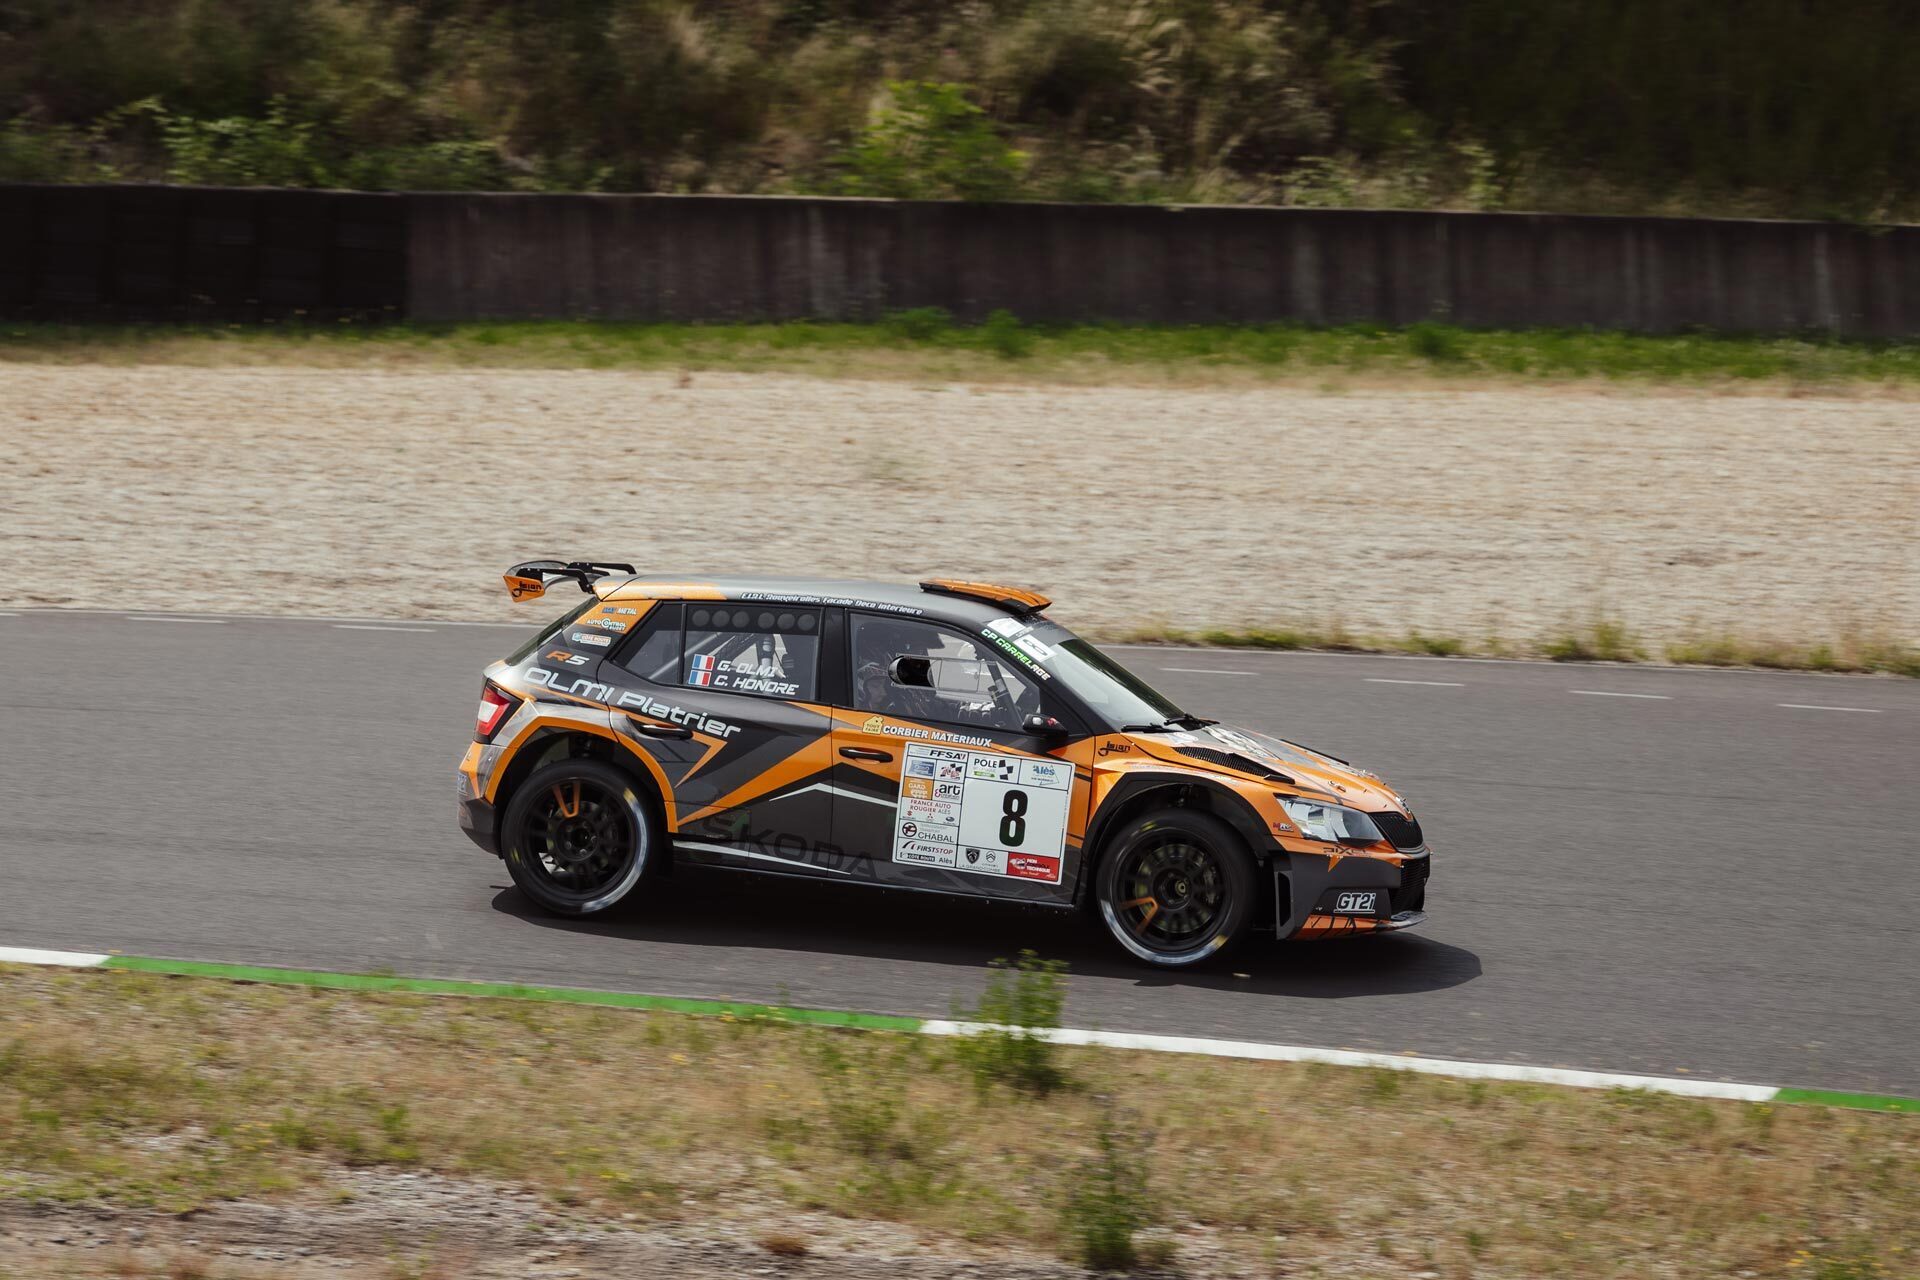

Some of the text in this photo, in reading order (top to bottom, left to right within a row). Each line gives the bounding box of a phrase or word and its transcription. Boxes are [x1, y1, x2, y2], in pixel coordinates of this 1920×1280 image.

[545, 650, 590, 665] R5
[981, 628, 997, 641] CP
[996, 638, 1051, 680] CARRELAGE
[717, 660, 777, 678] G. OLMI
[714, 675, 799, 695] C. HONORE
[524, 667, 741, 738] OLMI Platrier
[883, 725, 993, 747] CORBIER MATERIAUX
[929, 749, 961, 760] FFSA
[974, 758, 998, 769] POLE
[939, 784, 961, 796] art
[910, 799, 951, 809] FRANCE AUTO
[910, 805, 936, 813] ROUGIER
[999, 789, 1028, 847] 8
[917, 831, 954, 843] CHABAL
[916, 844, 953, 855] FIRSTSTOP
[1336, 892, 1376, 911] GT2i
